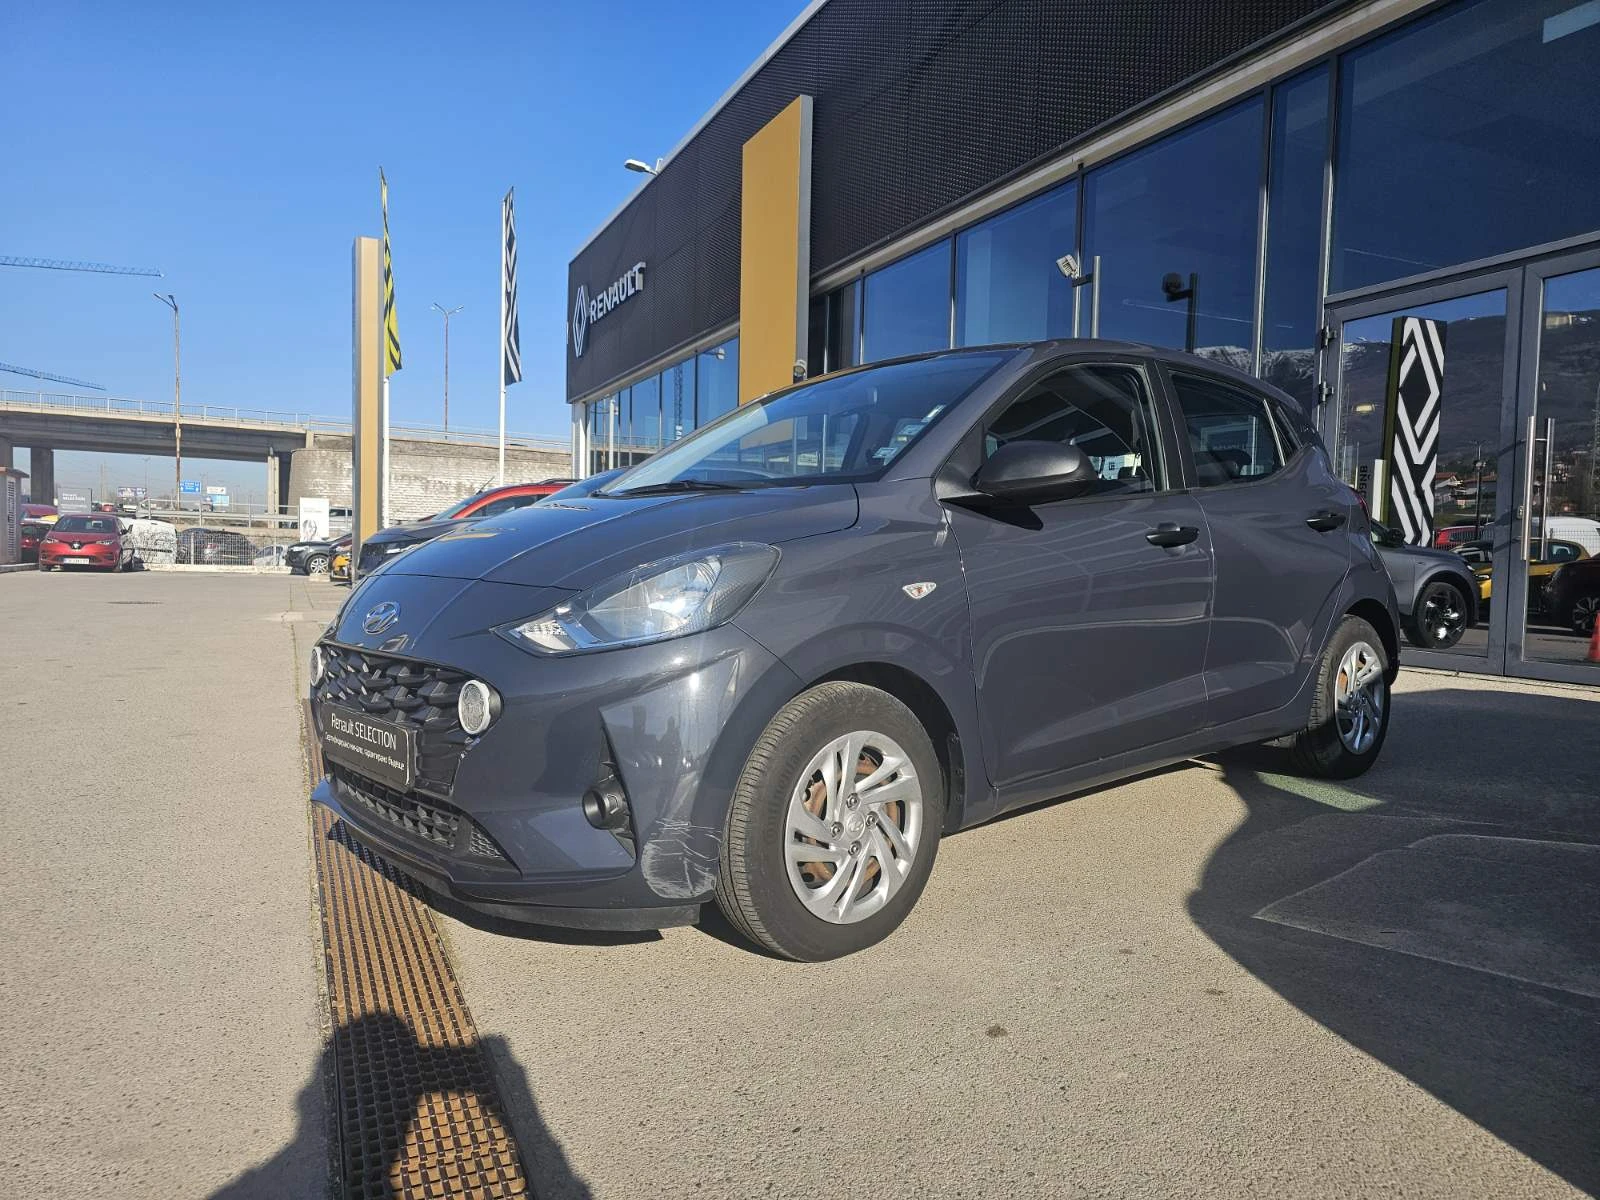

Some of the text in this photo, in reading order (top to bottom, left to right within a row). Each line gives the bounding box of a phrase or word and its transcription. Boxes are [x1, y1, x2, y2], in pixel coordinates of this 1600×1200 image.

[589, 261, 646, 324] RENAULT
[331, 713, 397, 750] Renault SELECTION
